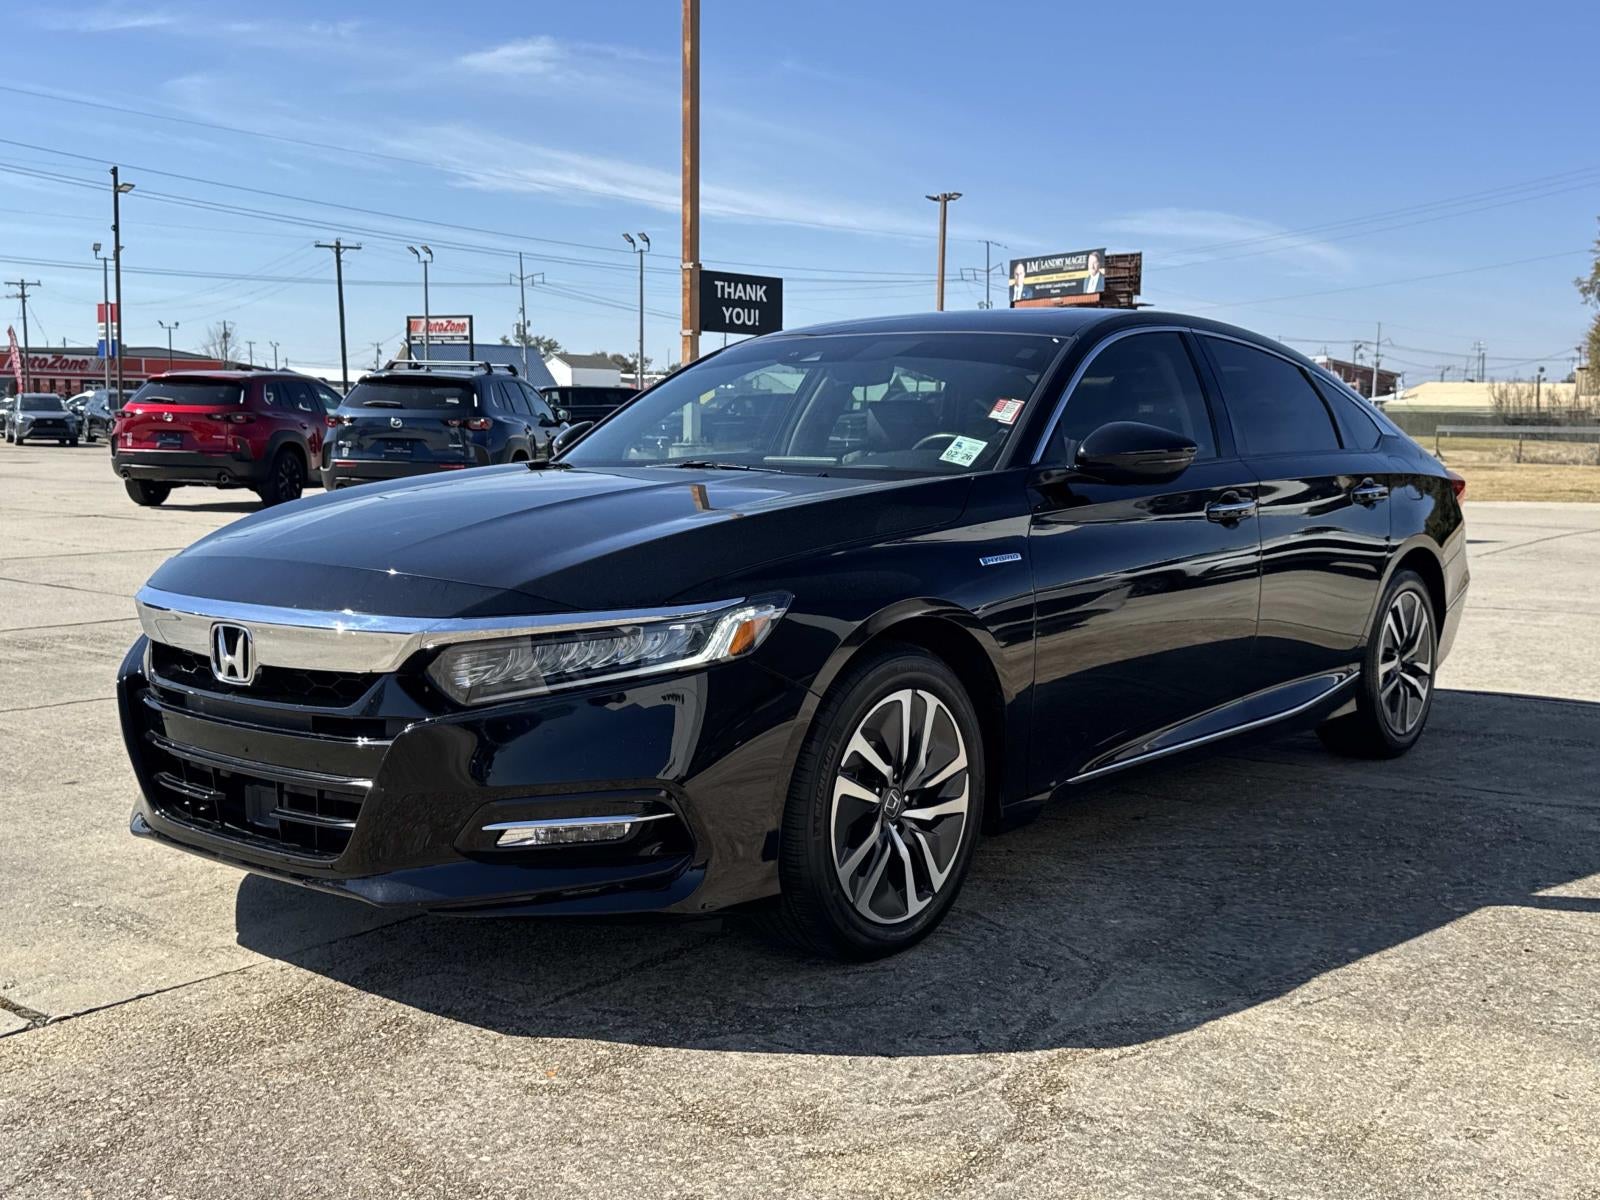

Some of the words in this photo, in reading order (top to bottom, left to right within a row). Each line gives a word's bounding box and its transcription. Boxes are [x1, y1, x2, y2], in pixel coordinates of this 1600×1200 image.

[714, 280, 767, 302] THANK
[722, 306, 759, 326] YOU!
[961, 453, 973, 461] 26
